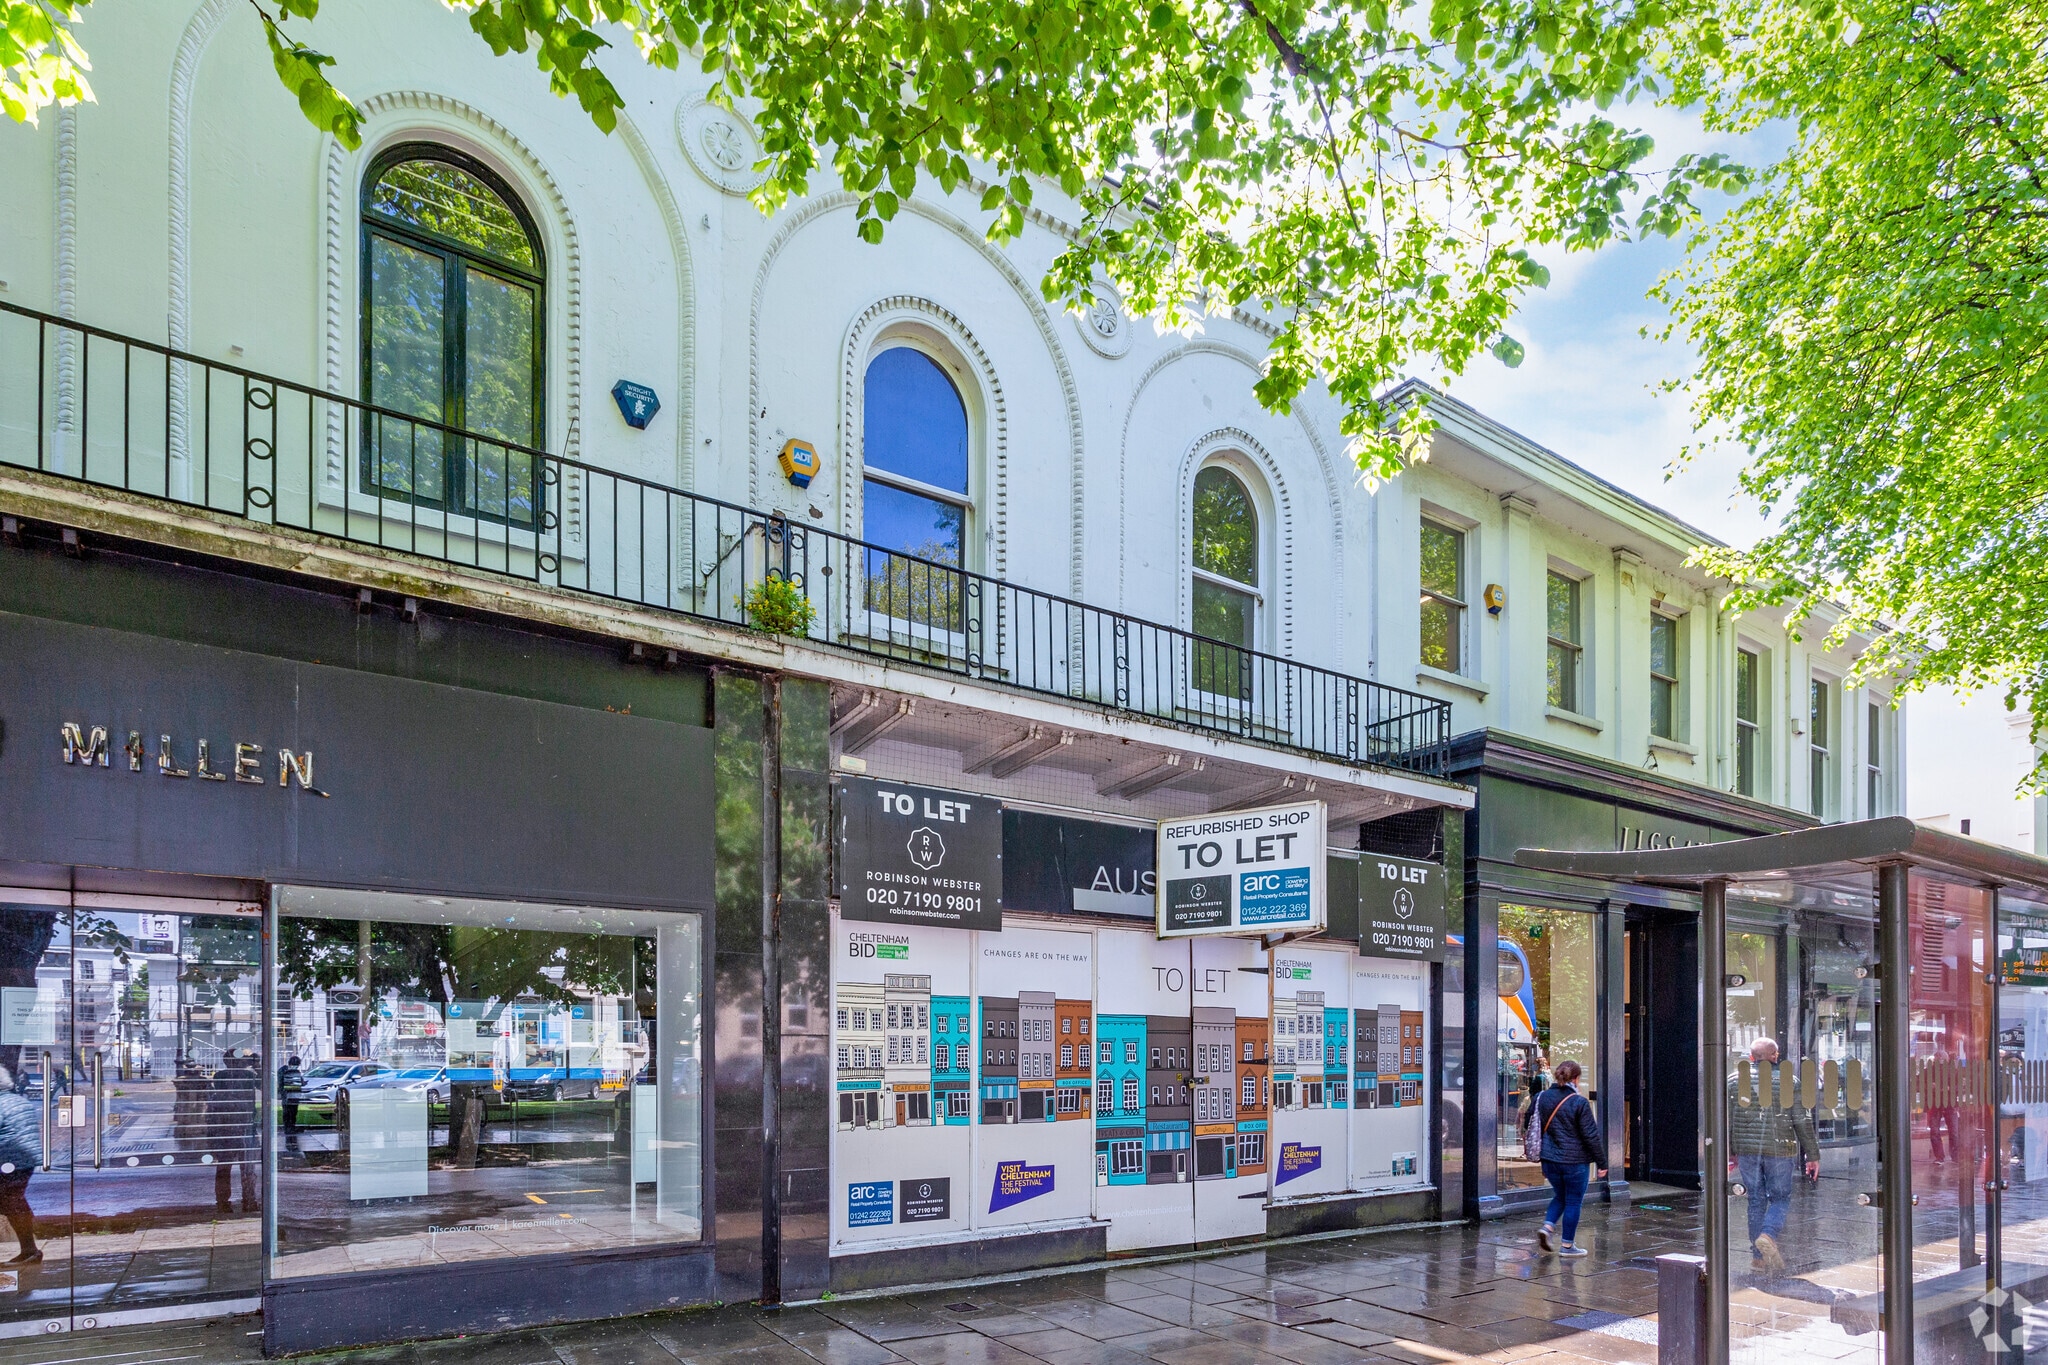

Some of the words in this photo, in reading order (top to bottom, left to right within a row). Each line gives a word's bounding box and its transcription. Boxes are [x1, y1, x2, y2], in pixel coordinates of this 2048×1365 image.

[625, 390, 654, 403] SECURITY
[628, 384, 651, 396] WRIGHT
[794, 451, 811, 464] ADT
[61, 722, 314, 788] MILLEN
[878, 791, 915, 816] TO
[924, 798, 971, 823] LET
[1166, 817, 1263, 839] REFURBISHED
[1269, 811, 1310, 827] SHOP
[923, 836, 930, 846] R
[1622, 826, 1709, 852] JIGS
[920, 851, 932, 861] W
[1178, 842, 1223, 869] TO
[1236, 832, 1297, 864] LET
[1378, 863, 1398, 880] TO
[1402, 866, 1428, 884] LET
[866, 871, 928, 885] ROBINSON
[933, 878, 981, 891] WEBSTER
[1243, 874, 1280, 892] arc
[867, 888, 897, 904] 020
[903, 891, 941, 909] 7190
[947, 895, 981, 912] 9801
[1278, 890, 1308, 898] Consultants
[890, 908, 960, 920] robinsonwebster.com
[1189, 911, 1205, 919] 7190
[1206, 910, 1222, 918] 9801
[1241, 905, 1267, 916] 01242
[1269, 904, 1287, 914] 222
[1289, 903, 1307, 912] 369
[1241, 911, 1307, 922] www.arcretail.co.uk
[1373, 921, 1404, 930] ROBINSON
[1407, 924, 1434, 933] WEBSTER
[849, 932, 909, 945] CHELTENHAM
[1373, 933, 1389, 944] 020
[1392, 935, 1412, 947] 7190
[1415, 937, 1434, 949] 9801
[849, 942, 876, 958] BID
[984, 949, 1021, 958] CHANGES
[1276, 959, 1312, 968] CHELTENHAM
[1276, 967, 1292, 979] BID
[1152, 967, 1183, 992] TO
[1194, 968, 1231, 993] LET
[1153, 1121, 1185, 1130] Restaurant
[1283, 1151, 1319, 1159] CHELTENHAM
[1001, 1170, 1051, 1180] CHELTENHAM
[1015, 1179, 1043, 1187] FESTIVAL
[851, 1186, 875, 1200] arc
[1001, 1187, 1021, 1195] TOWN
[850, 1212, 869, 1220] 01242
[869, 1210, 891, 1218] 222369
[428, 1225, 475, 1234] Discover
[475, 1223, 499, 1231] more
[512, 1217, 587, 1230] karenmillen.com
